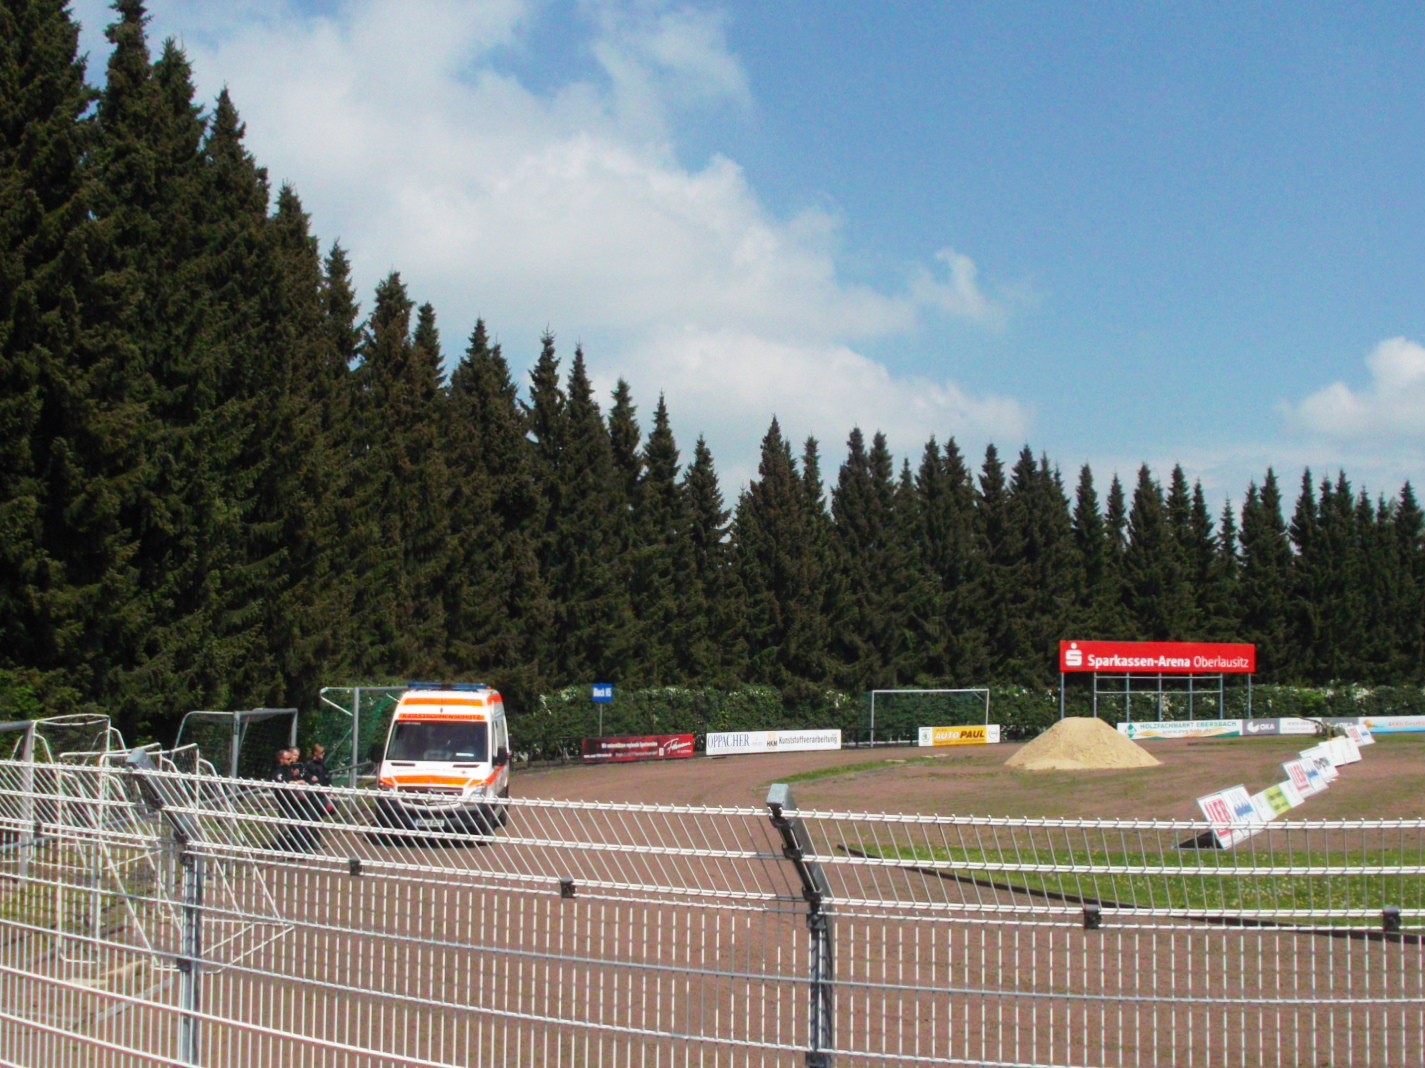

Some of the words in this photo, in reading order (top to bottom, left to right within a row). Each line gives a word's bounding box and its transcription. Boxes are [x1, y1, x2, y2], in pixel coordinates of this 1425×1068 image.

[1088, 655, 1190, 668] Sparkassen-Arena
[1193, 656, 1249, 668] Oberlausitz
[960, 730, 985, 738] PAUL
[707, 734, 750, 748] OPPACHER
[778, 735, 838, 745] Kunststoffverarbeitung
